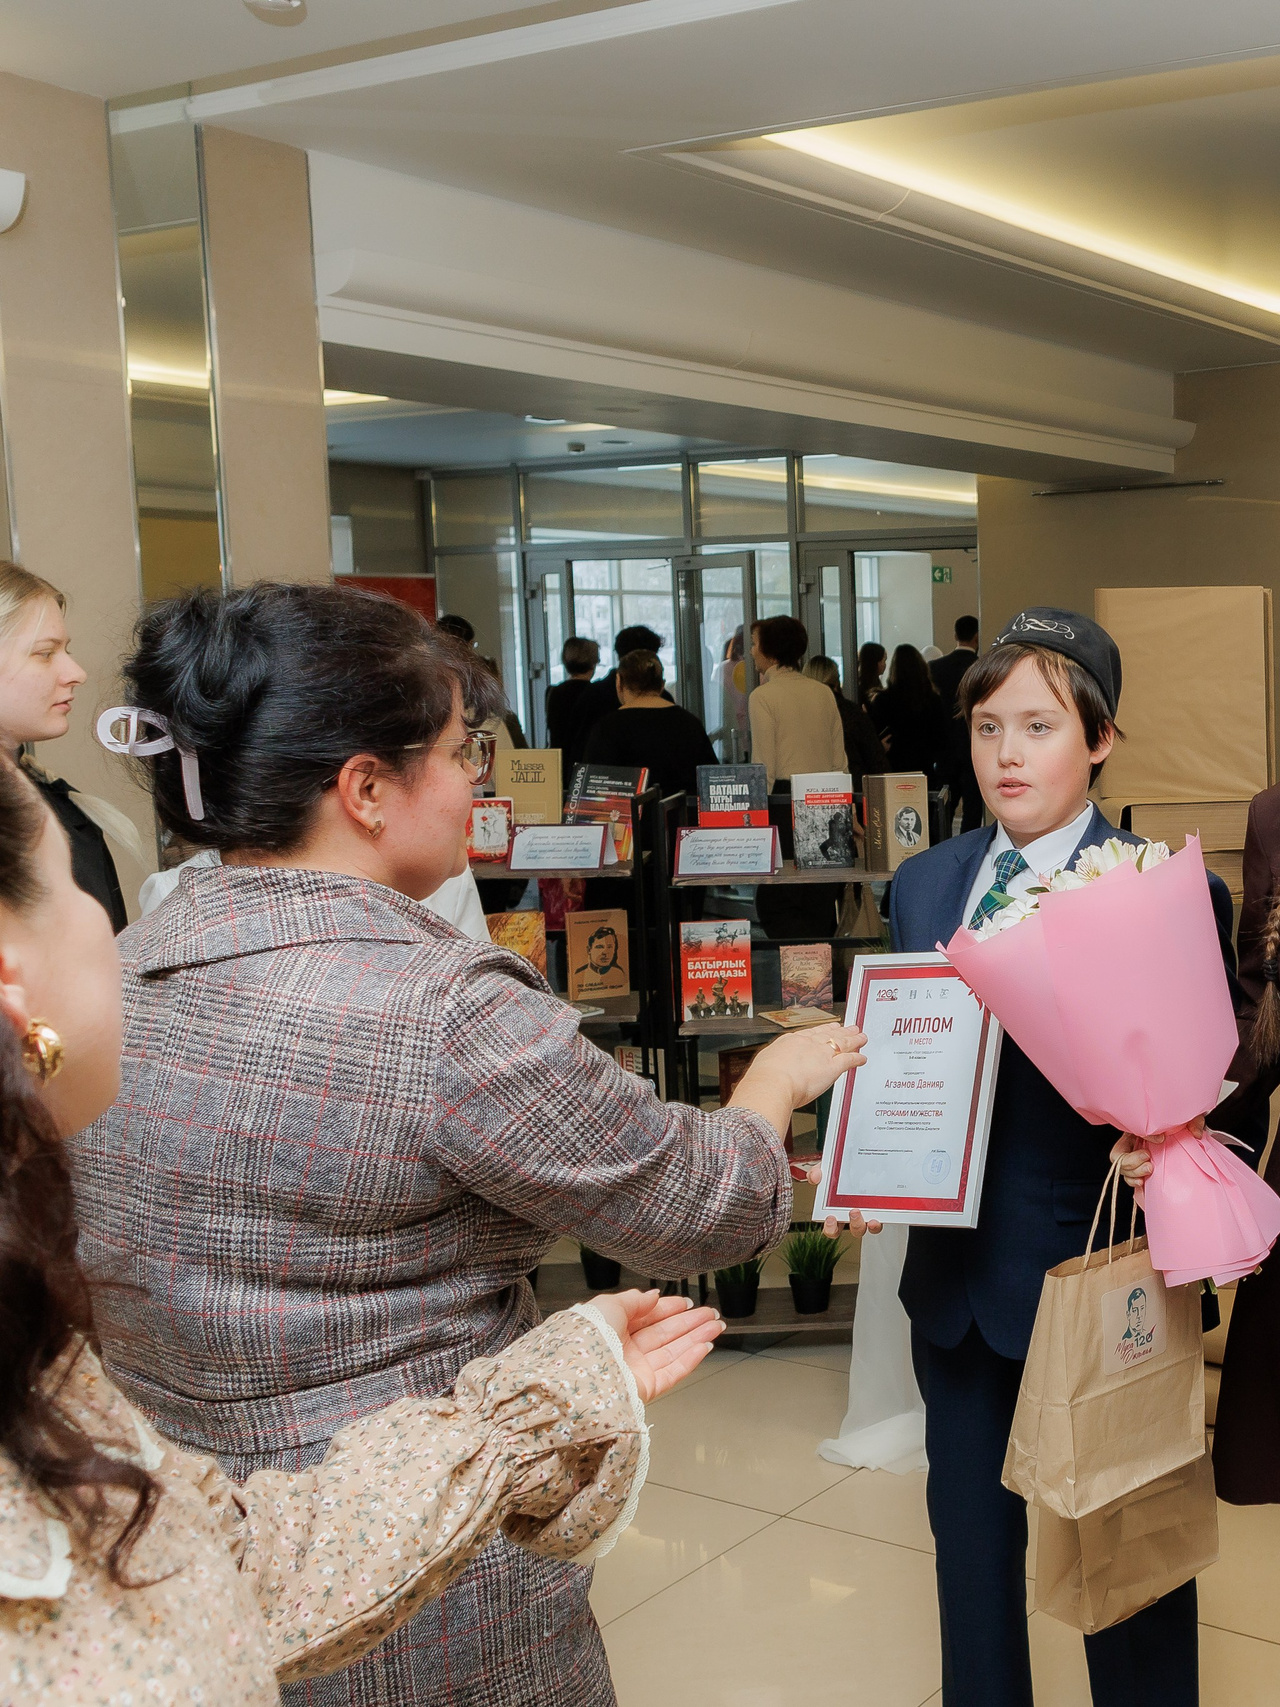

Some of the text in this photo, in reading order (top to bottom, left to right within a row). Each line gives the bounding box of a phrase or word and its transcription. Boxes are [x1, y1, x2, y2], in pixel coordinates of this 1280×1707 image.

[511, 760, 545, 771] Mussa
[511, 771, 546, 783] JALIL
[570, 767, 586, 810] СЛОВАРЬ
[710, 784, 749, 795] ВАТАНГА
[710, 795, 732, 803] ТУГРЫ
[710, 803, 750, 812] КАЛДЫЛАР
[687, 960, 746, 970] БАТЫРЛЫК
[688, 969, 747, 979] КАЙТАВАЗЫ
[892, 1017, 953, 1036] ДИПЛОМ
[885, 1079, 944, 1090] Агзамов Данияр
[1134, 1331, 1153, 1348] 120
[1114, 1340, 1134, 1359] Муса
